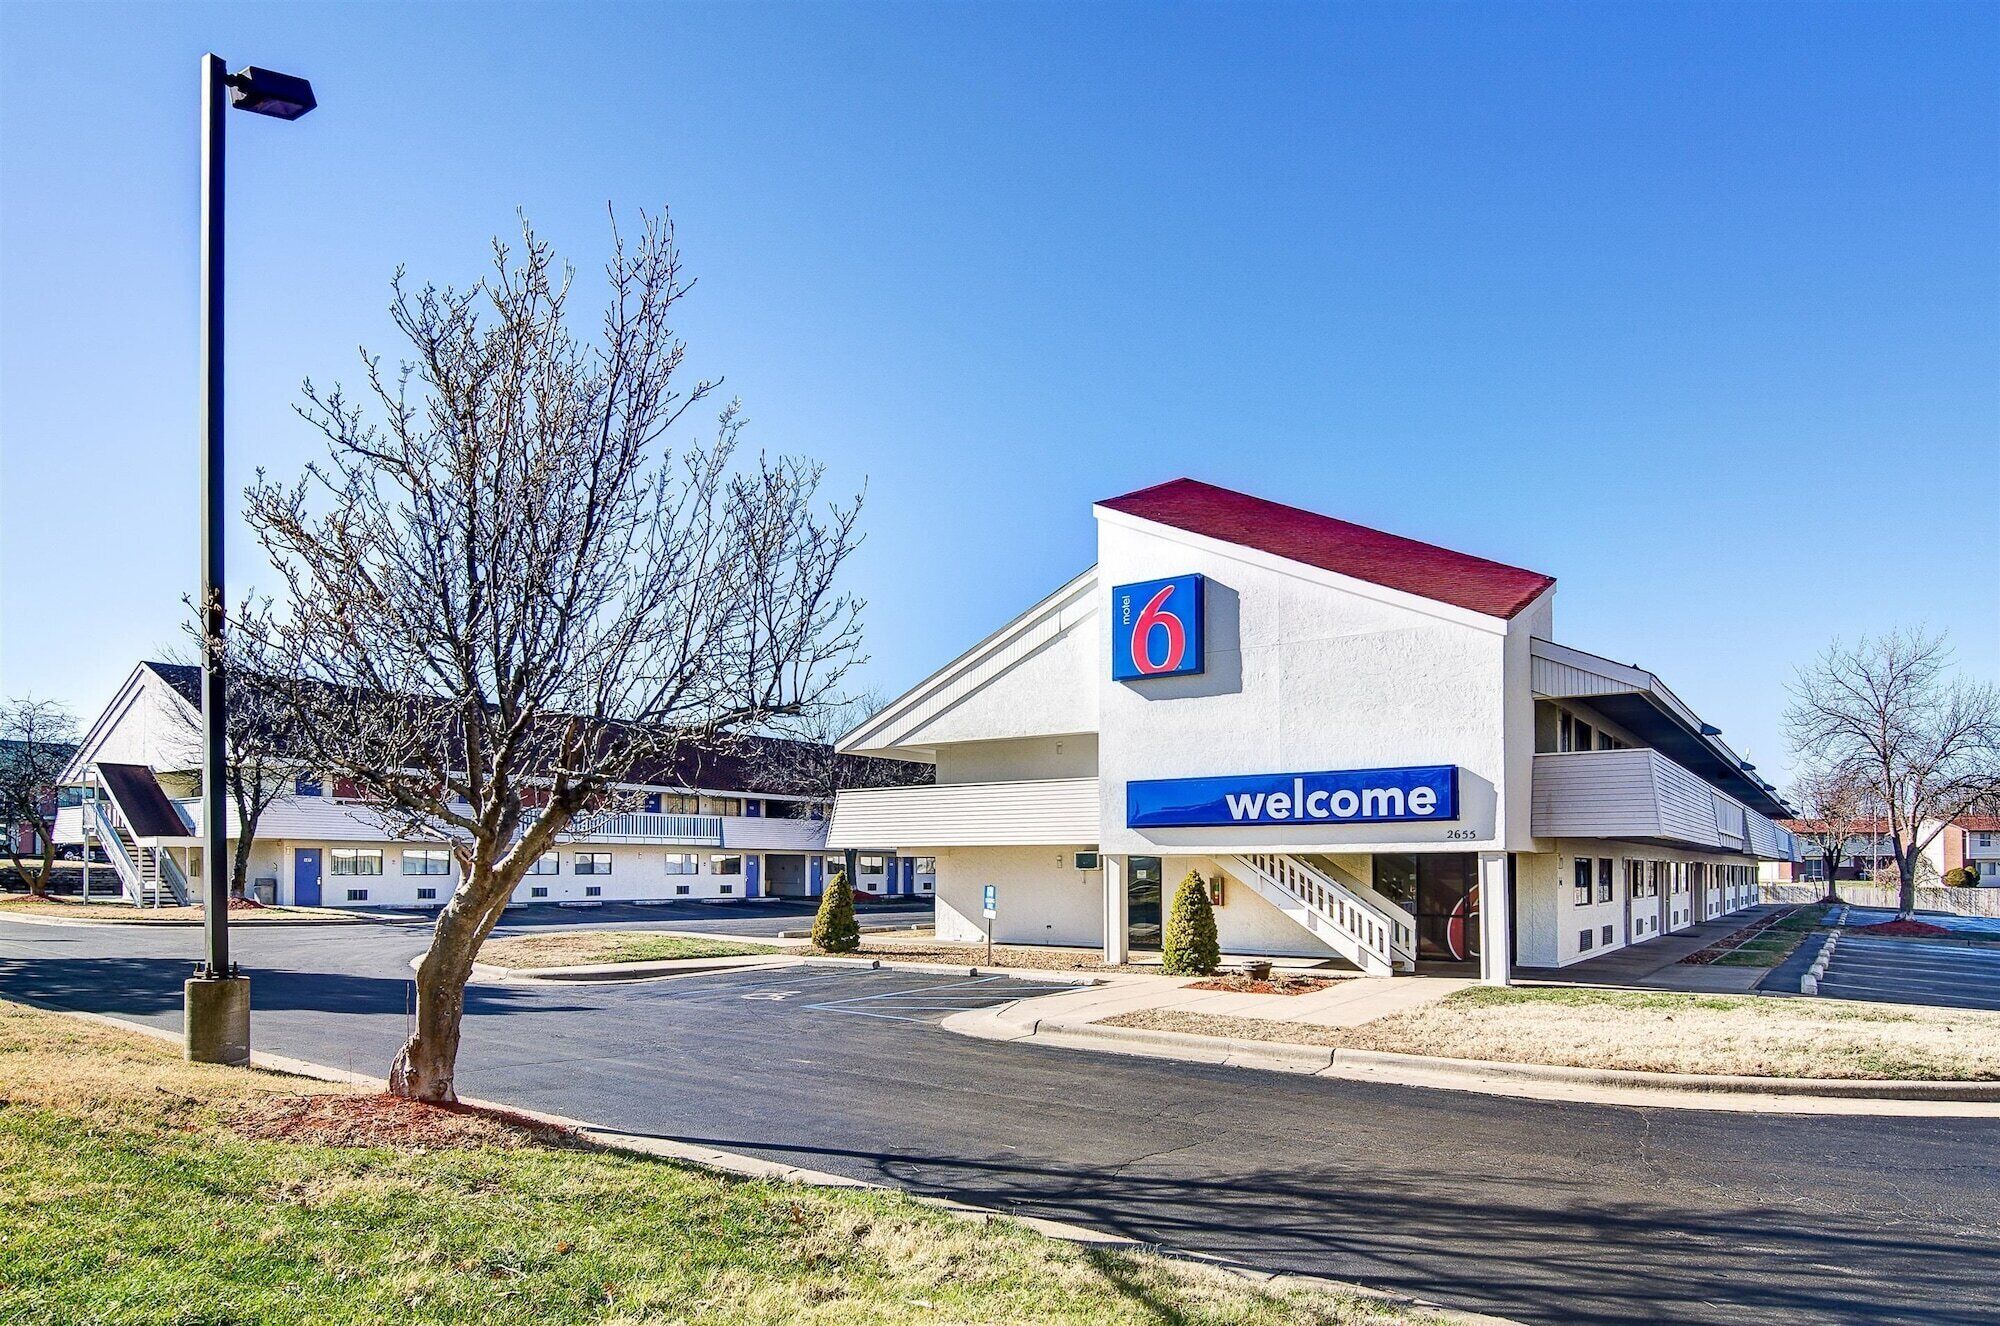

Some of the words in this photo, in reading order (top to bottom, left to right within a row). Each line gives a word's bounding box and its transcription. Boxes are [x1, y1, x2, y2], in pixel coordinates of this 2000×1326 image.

[1122, 595, 1131, 625] motel
[1131, 585, 1186, 674] 6
[1225, 778, 1437, 820] welcome
[1447, 830, 1476, 839] 2655
